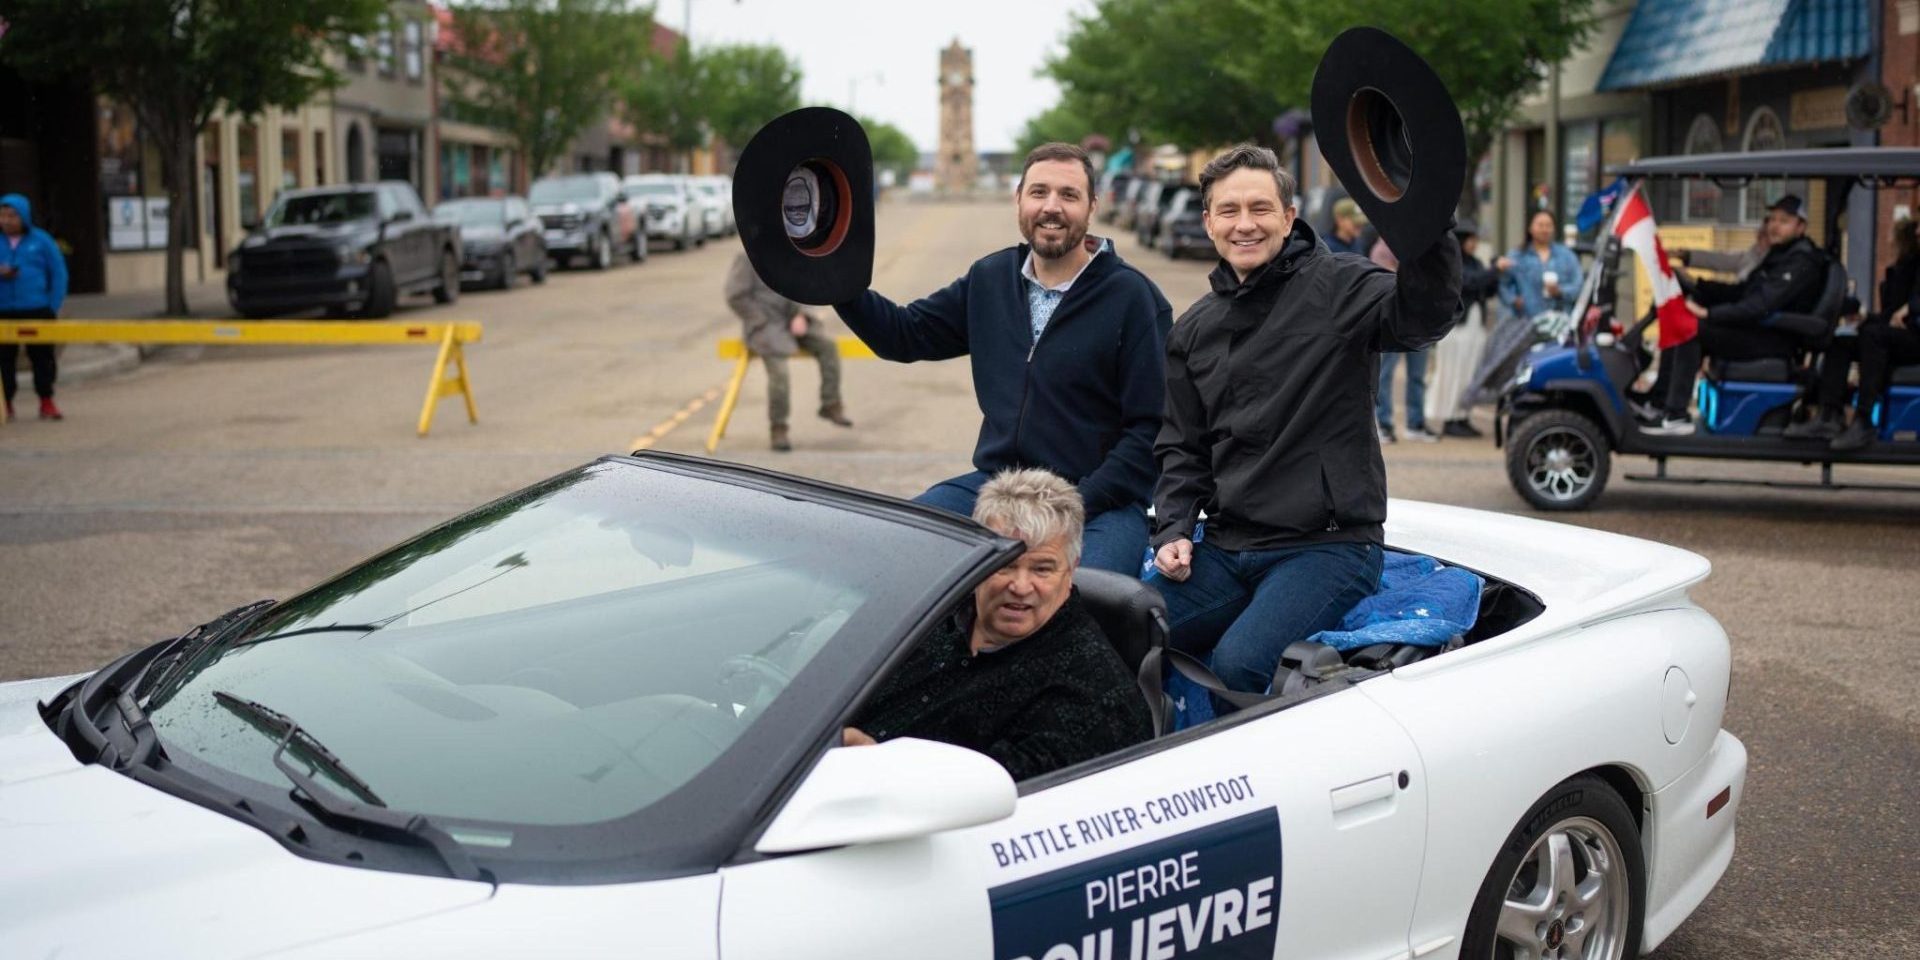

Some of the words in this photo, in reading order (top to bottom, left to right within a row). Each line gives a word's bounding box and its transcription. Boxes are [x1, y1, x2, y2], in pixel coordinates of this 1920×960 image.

[991, 824, 1077, 868] BATTLE
[1077, 774, 1255, 844] RIVER-CROWFOOT
[1008, 876, 1274, 960] ILIEVRE
[1086, 850, 1201, 919] PIERRE
